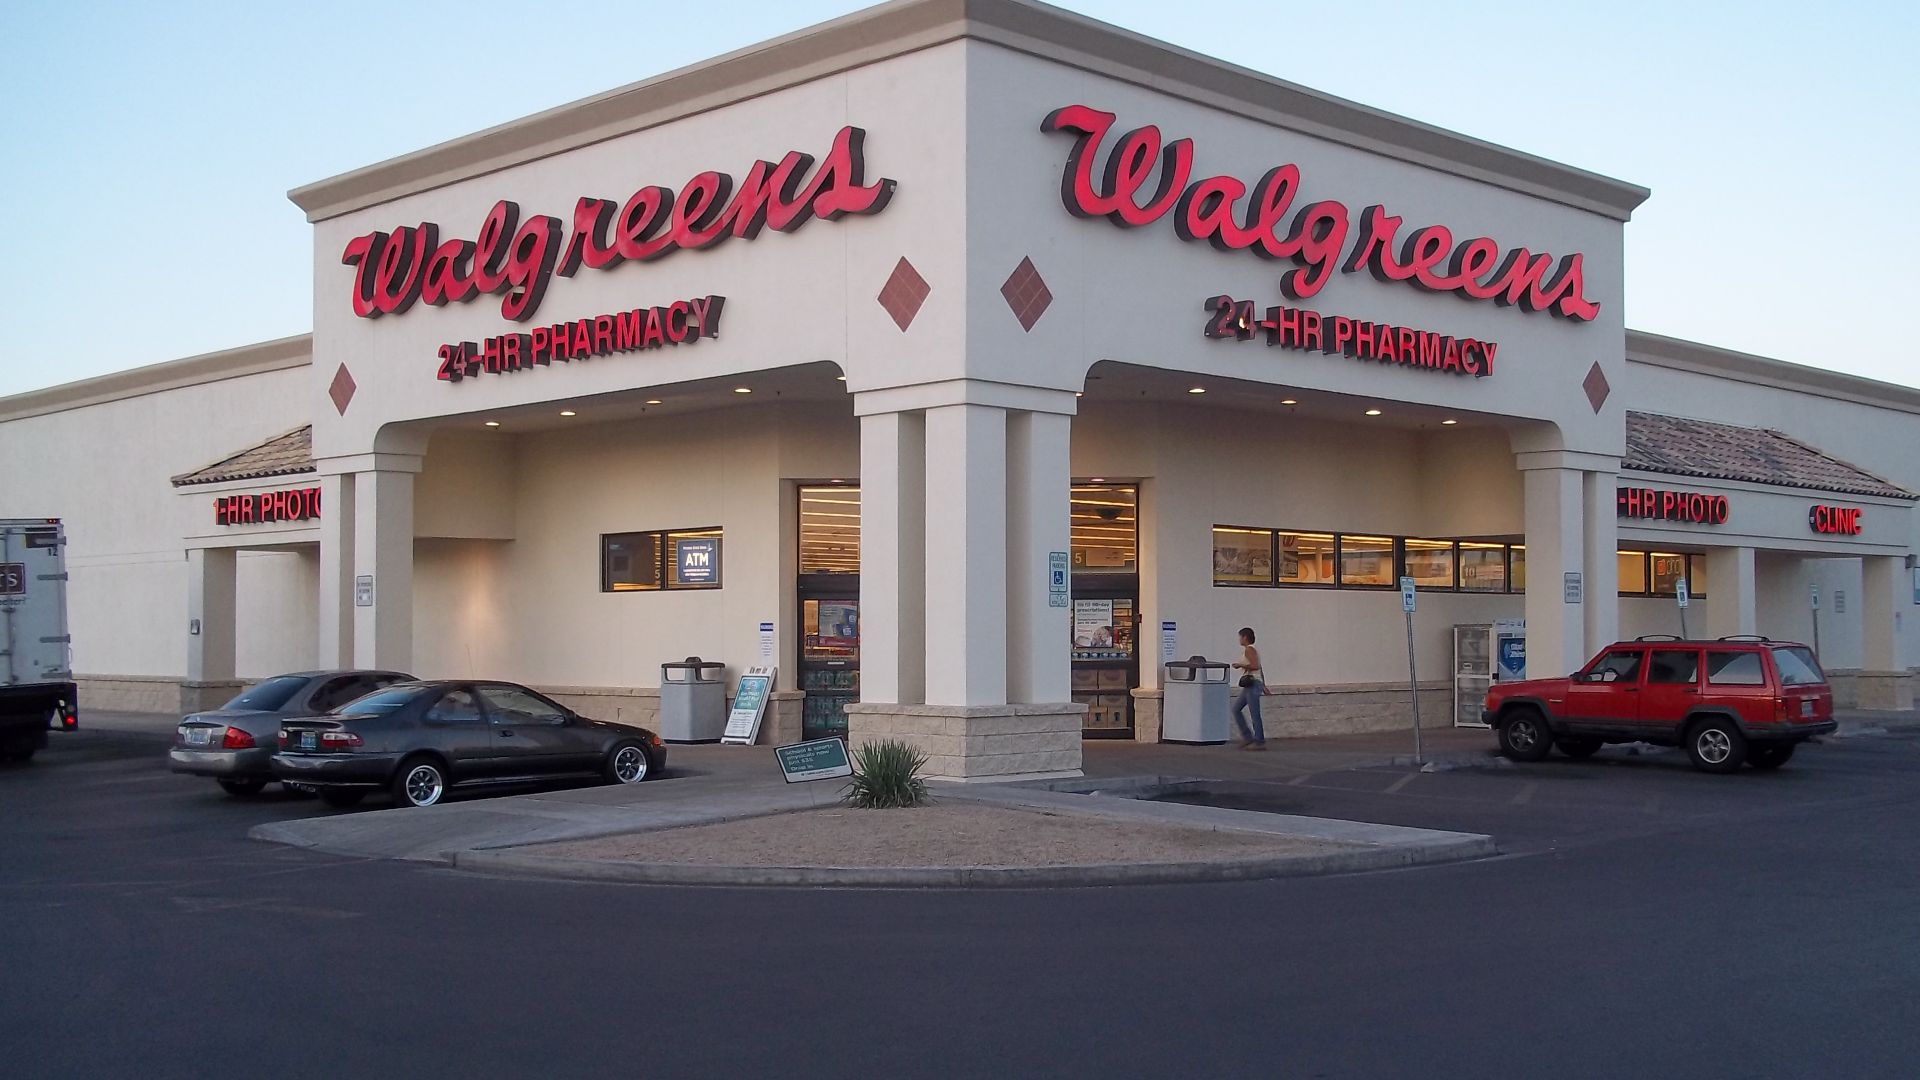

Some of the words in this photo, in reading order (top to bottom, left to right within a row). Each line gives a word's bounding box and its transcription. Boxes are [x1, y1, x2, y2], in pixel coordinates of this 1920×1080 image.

[342, 126, 897, 322] Walgreens
[1040, 104, 1600, 321] Walgreens
[437, 333, 525, 382] 24-HR
[531, 295, 721, 365] PHARMACY
[1208, 295, 1323, 351] 24-HR
[1333, 315, 1497, 376] PHARMACY
[213, 495, 254, 525] 1-HR
[1618, 487, 1656, 518] -HR
[1663, 491, 1728, 524] PHOTO
[1814, 504, 1863, 536] CLINIC
[47, 548, 58, 556] 12
[685, 552, 709, 567] ATM
[1075, 552, 1082, 564] 5
